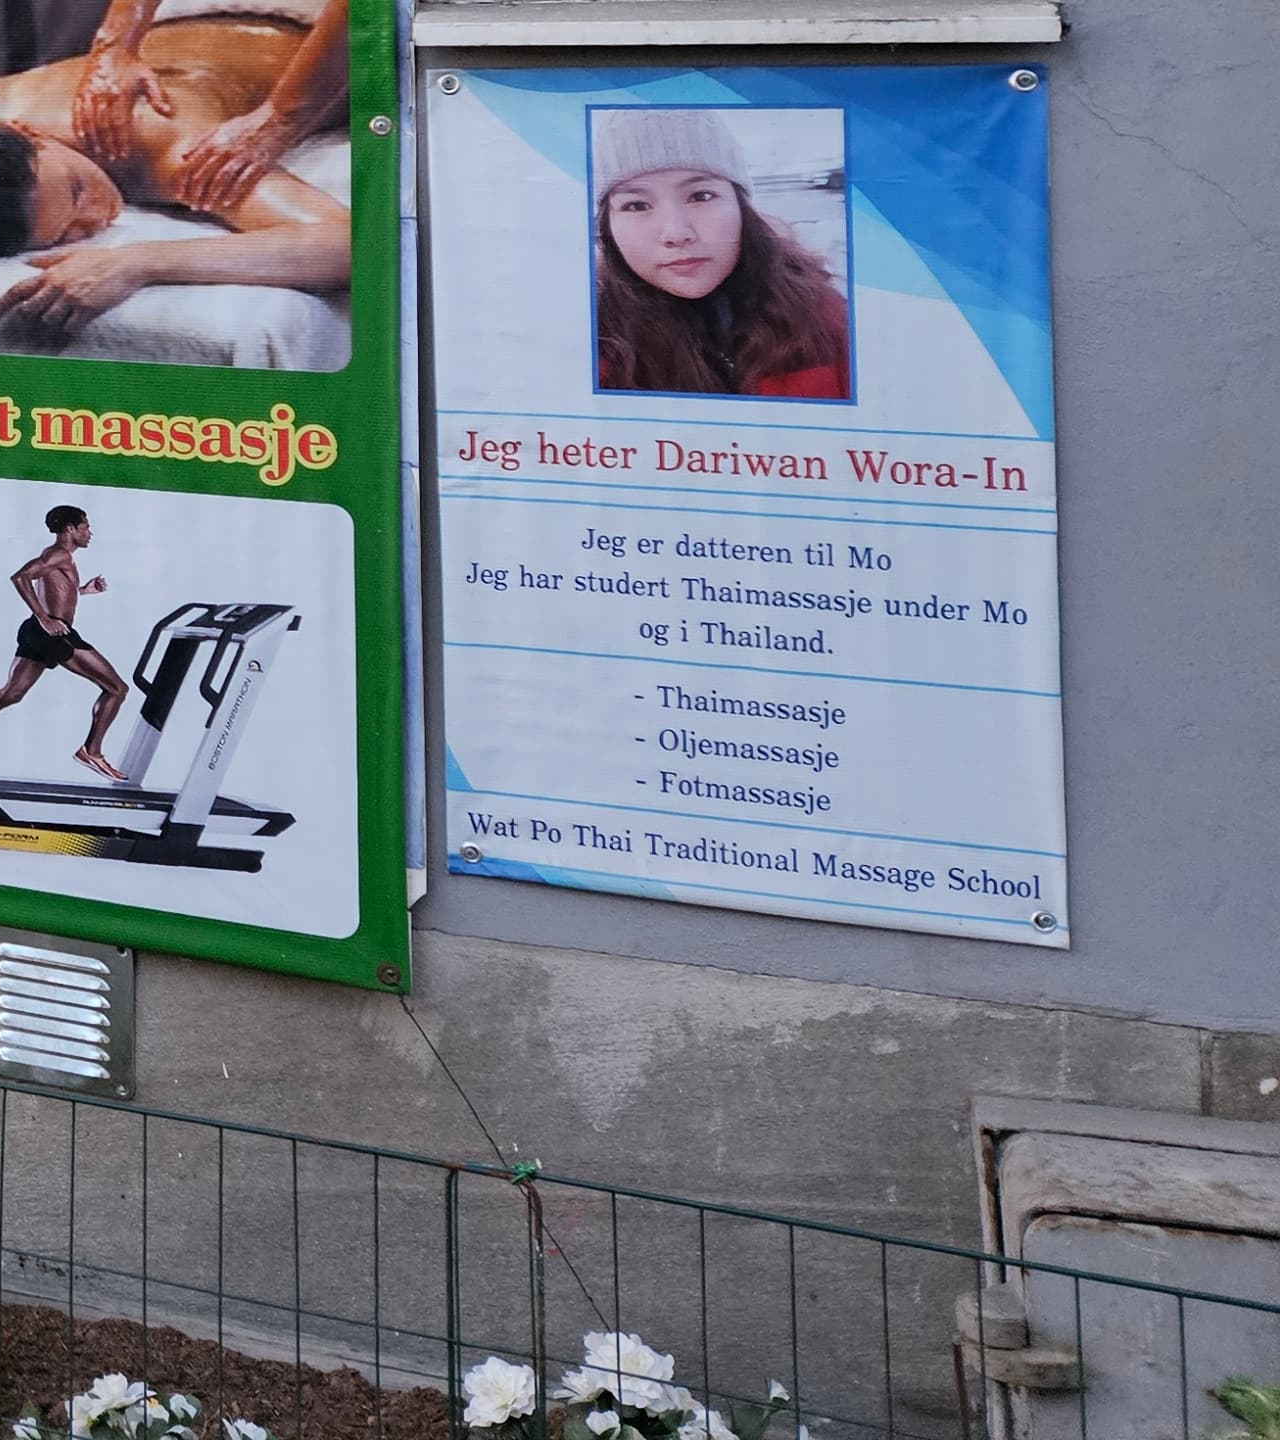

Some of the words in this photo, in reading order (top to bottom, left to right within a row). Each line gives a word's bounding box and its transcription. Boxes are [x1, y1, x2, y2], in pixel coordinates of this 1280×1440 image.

[31, 402, 339, 487] massasje
[459, 431, 522, 471] Jeg
[537, 431, 638, 470] heter
[655, 440, 829, 480] Dariwan
[846, 449, 1028, 491] Wora-In
[581, 528, 627, 558] Jeg
[637, 537, 664, 555] er
[675, 533, 793, 565] datteren
[804, 542, 834, 568] til
[848, 545, 892, 571] Mo
[465, 562, 509, 591] Jeg
[519, 564, 564, 591] har
[574, 571, 671, 599] studert
[681, 577, 873, 618] Thaimassasje
[884, 594, 971, 621] under
[982, 599, 1028, 626] Mo
[639, 622, 670, 646] og
[681, 619, 688, 642] i
[700, 621, 834, 655] Thailand.
[656, 685, 846, 730] Thaimassasje
[659, 729, 840, 773] Oljemassasje
[659, 770, 832, 816] Fotmassasje
[468, 811, 520, 839] Wat
[530, 819, 562, 844] Po
[572, 824, 633, 853] Thai
[645, 833, 799, 873] Traditional
[812, 852, 936, 893] Massage
[948, 867, 1041, 900] School
